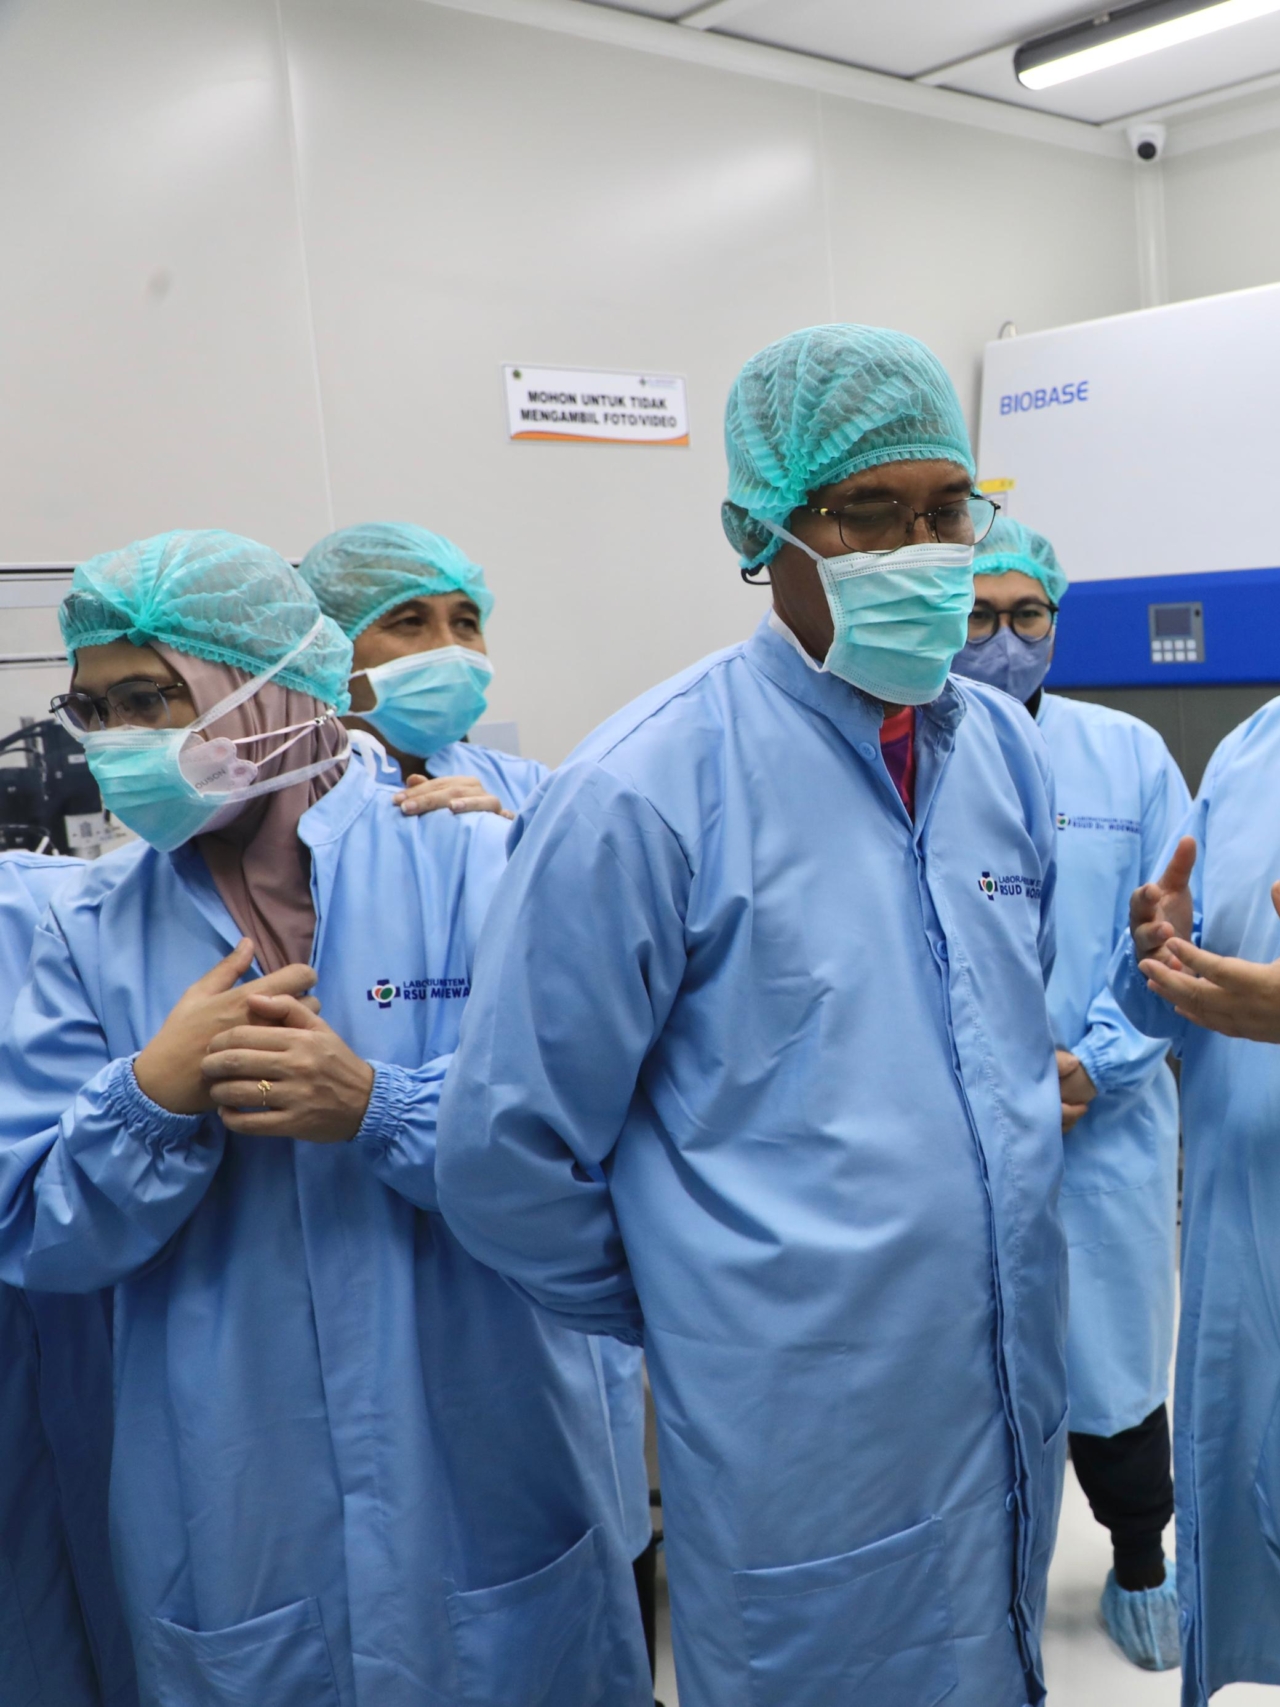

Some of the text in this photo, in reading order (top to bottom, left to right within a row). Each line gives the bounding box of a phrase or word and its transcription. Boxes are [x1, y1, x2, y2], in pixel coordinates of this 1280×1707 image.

[527, 390, 667, 410] MOHON UNTUK TIDAK
[1000, 380, 1089, 416] BIOBASE
[520, 408, 677, 428] MENGAMBIL FOTO/VIDEO
[999, 884, 1022, 896] RSUD
